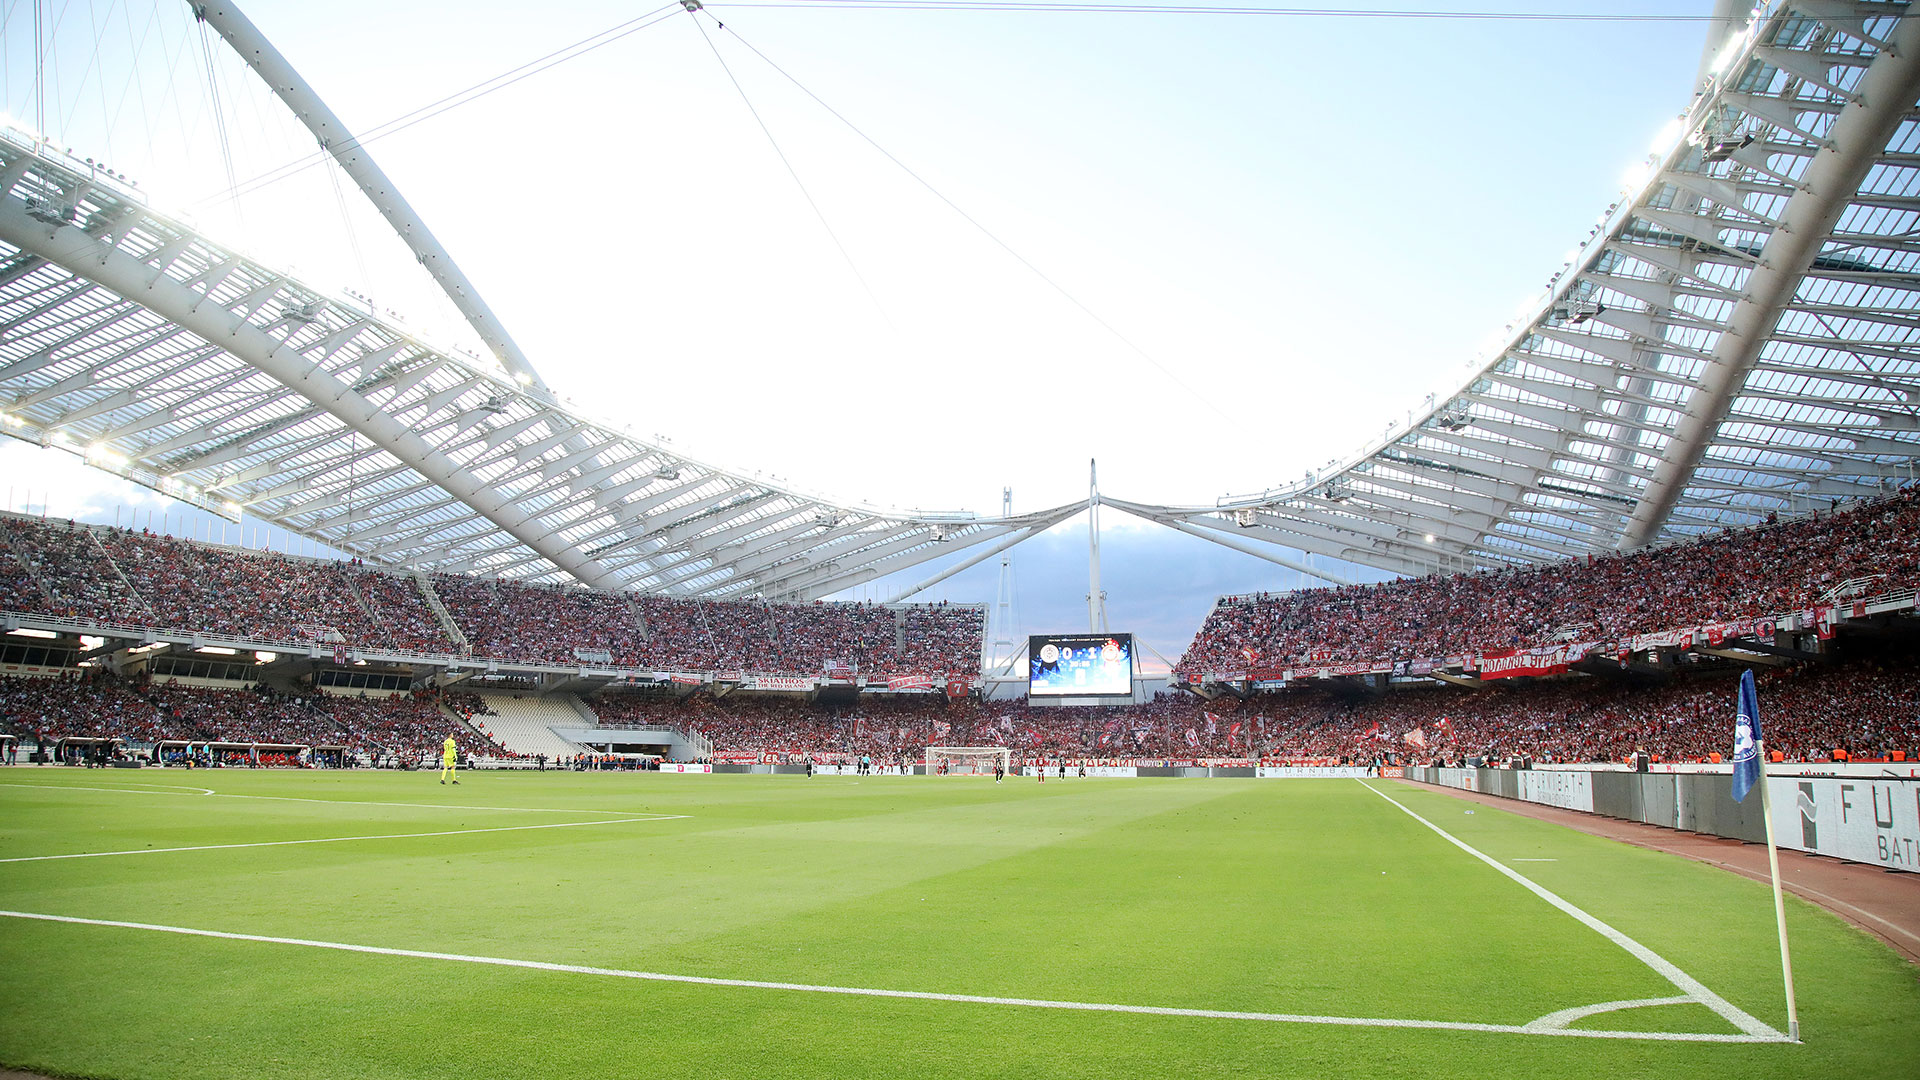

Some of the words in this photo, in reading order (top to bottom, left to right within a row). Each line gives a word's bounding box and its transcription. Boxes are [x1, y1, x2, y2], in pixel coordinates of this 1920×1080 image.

[1062, 647, 1073, 660] 0
[1088, 647, 1097, 659] 1
[758, 677, 805, 685] SKIATHOS
[954, 683, 962, 694] 7
[1841, 784, 1920, 834] FU
